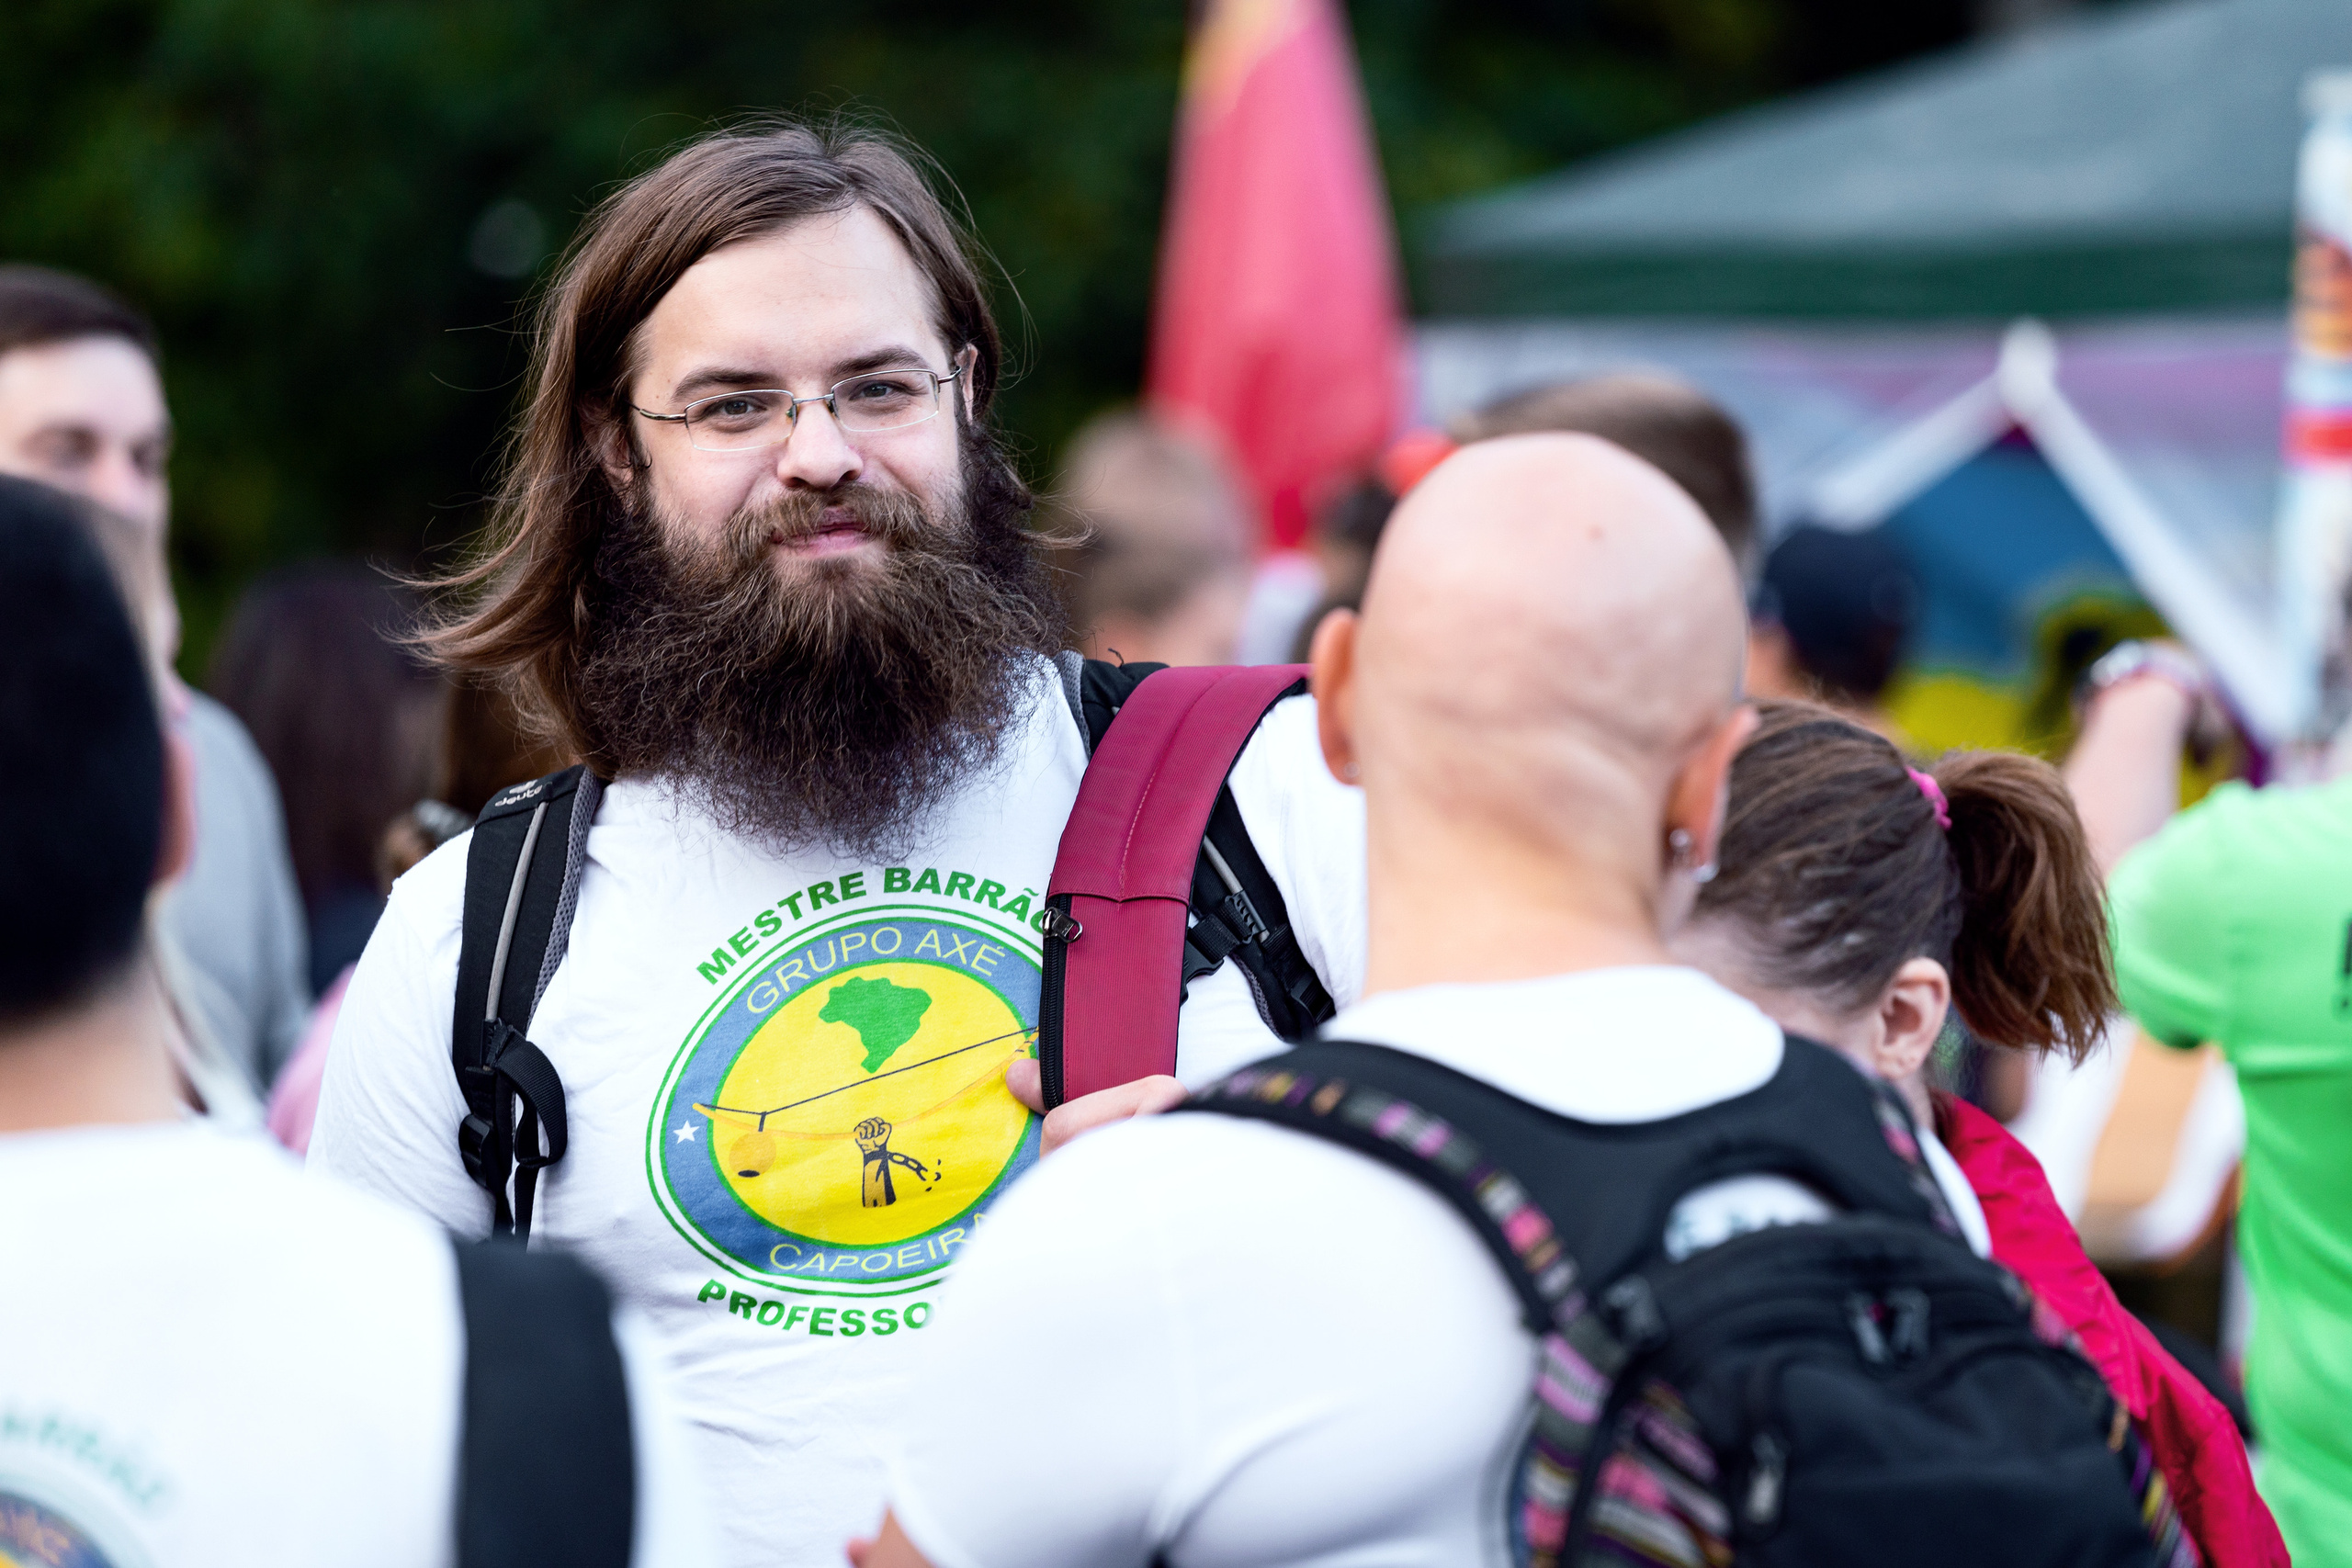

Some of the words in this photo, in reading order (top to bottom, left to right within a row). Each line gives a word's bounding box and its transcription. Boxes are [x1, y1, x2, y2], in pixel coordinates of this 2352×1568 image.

[494, 784, 543, 807] deute
[695, 871, 867, 986] MESTRE
[746, 926, 902, 1013] GRUPO
[914, 929, 1006, 976] AXÉ
[696, 1278, 935, 1337] PROFESSO
